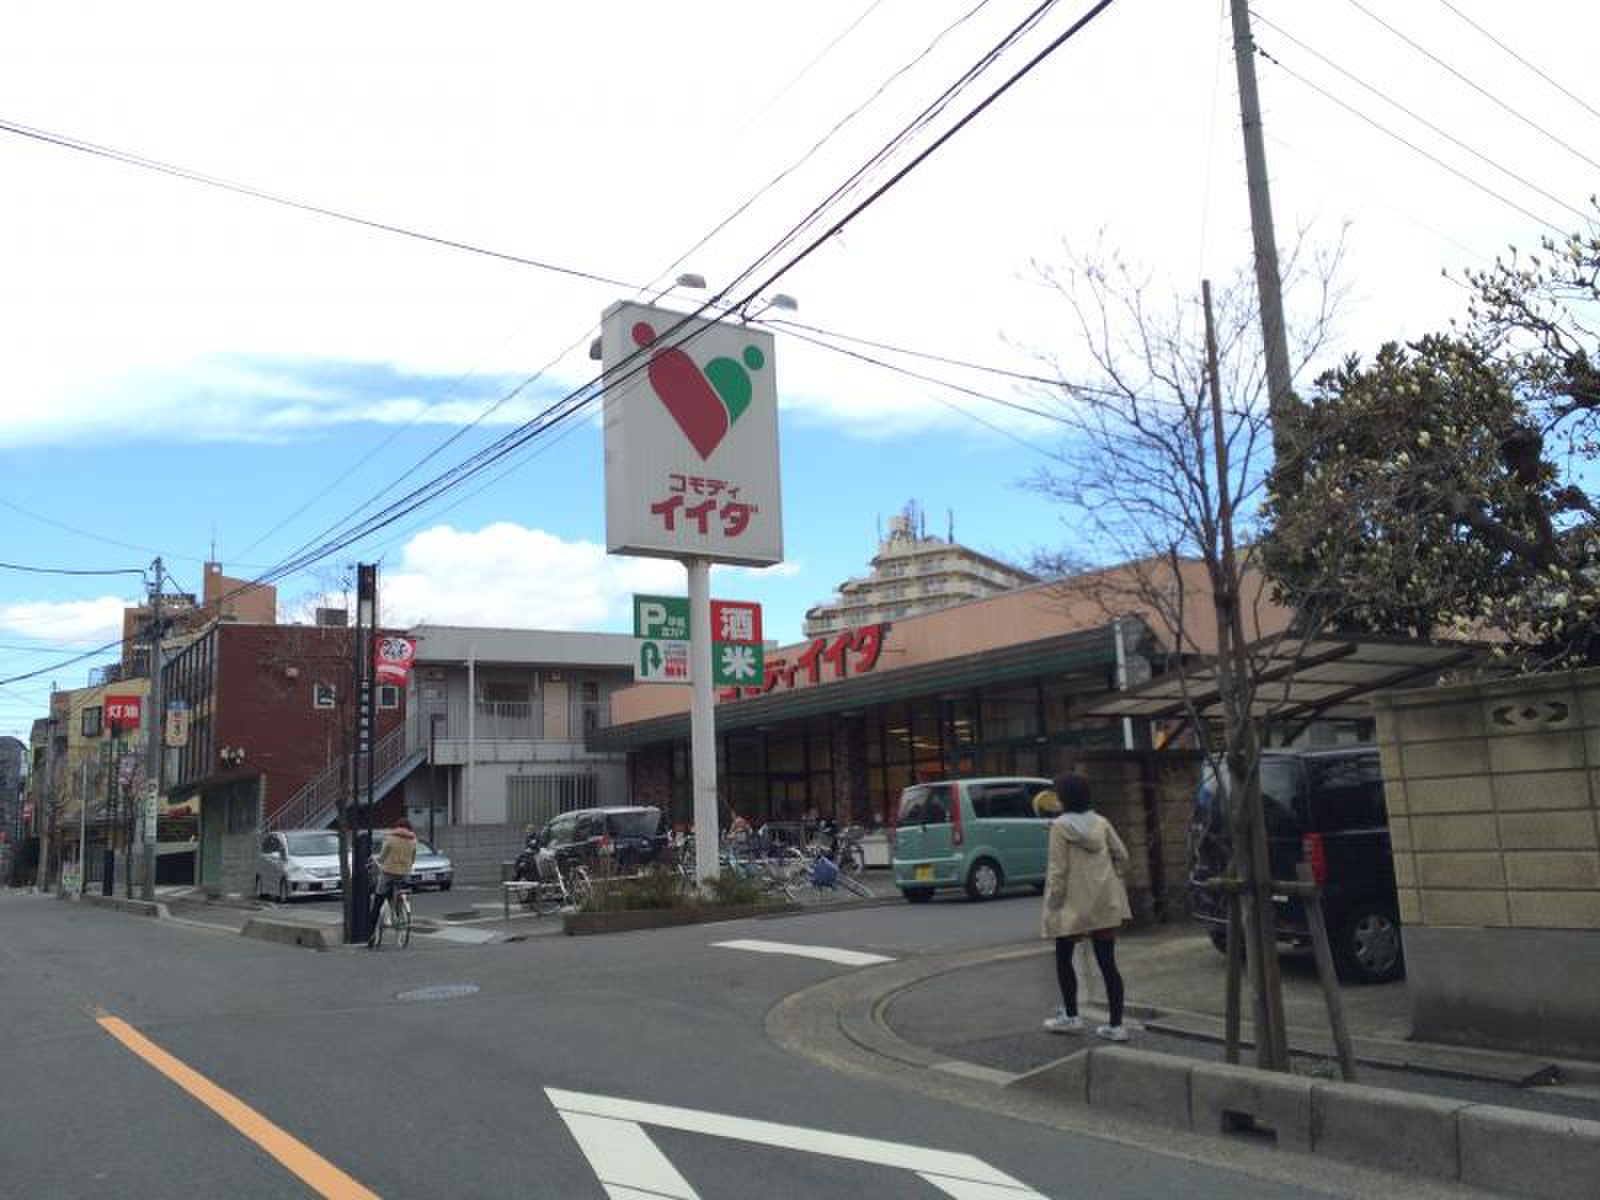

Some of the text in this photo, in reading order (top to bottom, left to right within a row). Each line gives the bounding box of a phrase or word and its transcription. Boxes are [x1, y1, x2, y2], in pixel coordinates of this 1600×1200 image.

[669, 473, 740, 499] コモディ
[650, 495, 759, 537] イイダ
[640, 602, 667, 636] P
[720, 607, 753, 641] 酒
[721, 645, 757, 680] 米
